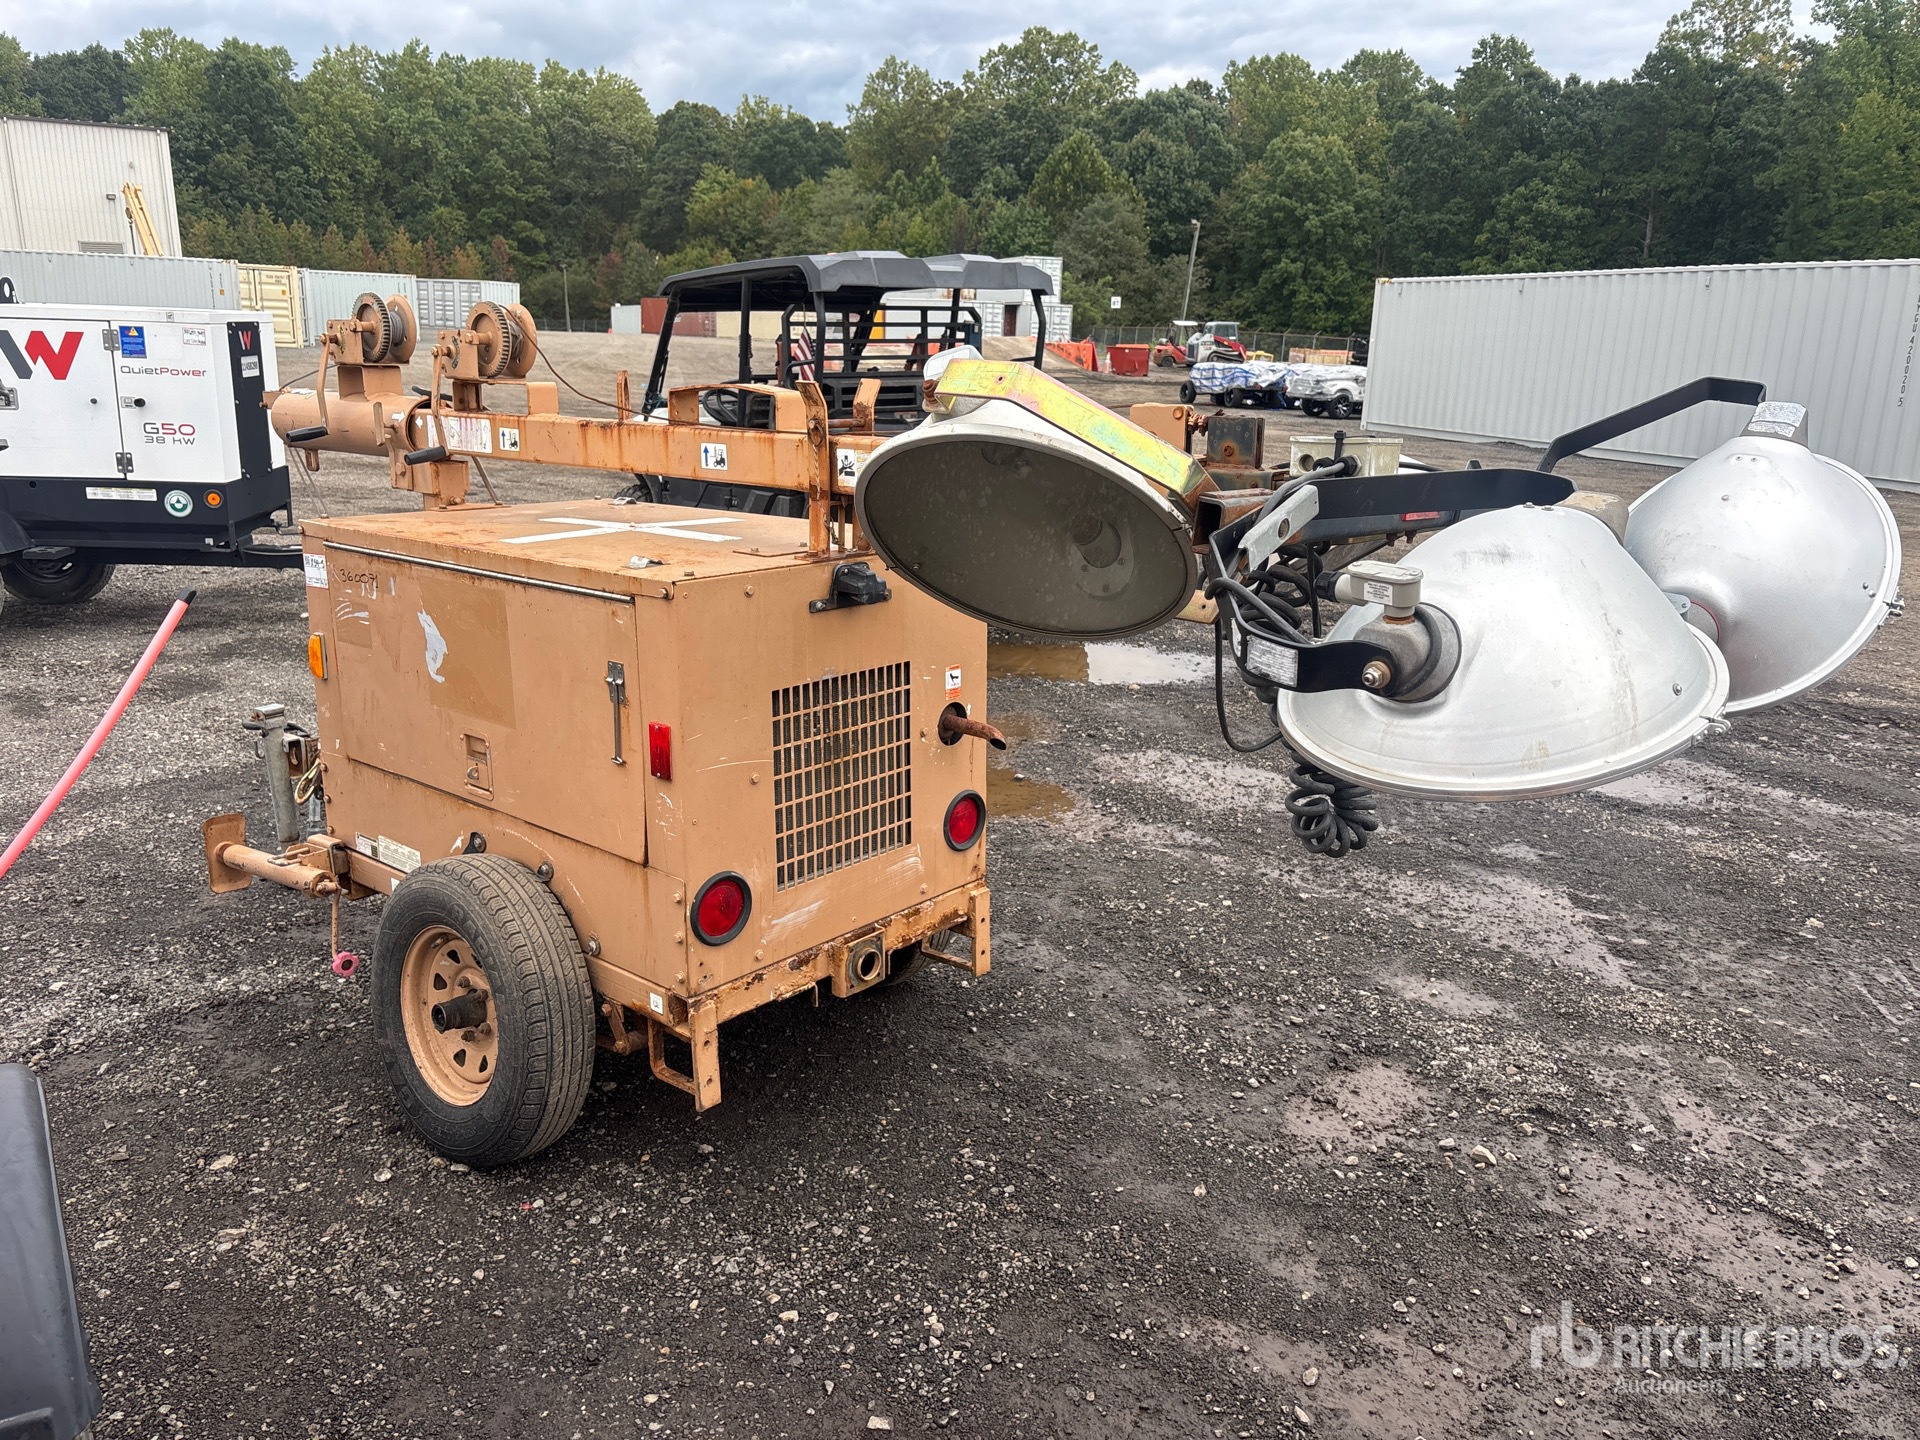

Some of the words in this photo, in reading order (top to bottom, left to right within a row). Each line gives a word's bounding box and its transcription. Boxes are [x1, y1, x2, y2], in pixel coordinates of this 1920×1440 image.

[120, 365, 207, 377] QuietPower
[143, 422, 196, 436] G50
[144, 435, 166, 444] 38
